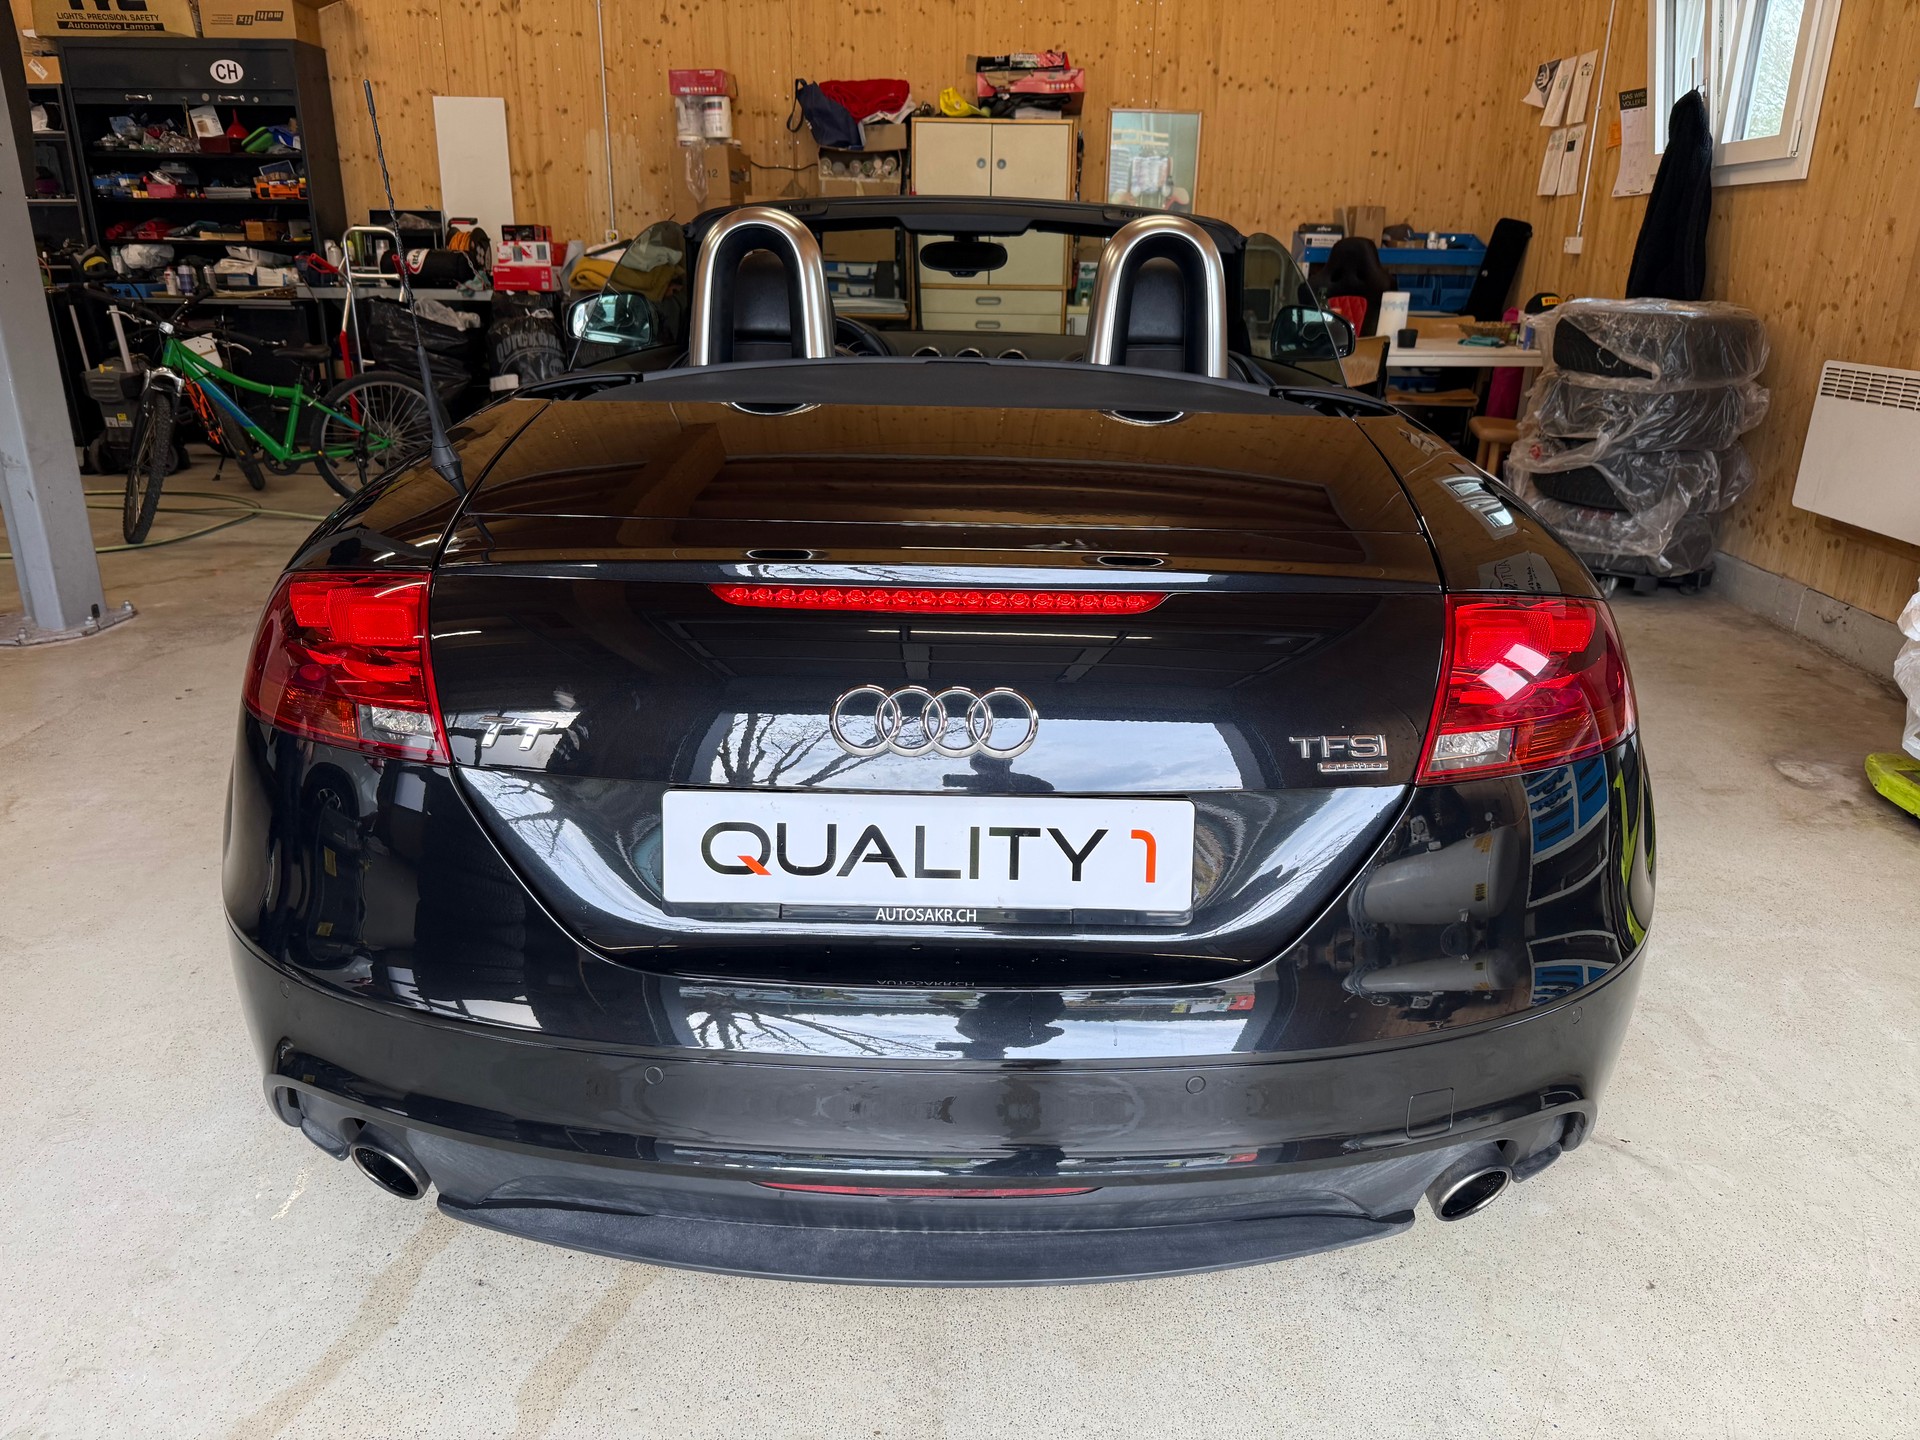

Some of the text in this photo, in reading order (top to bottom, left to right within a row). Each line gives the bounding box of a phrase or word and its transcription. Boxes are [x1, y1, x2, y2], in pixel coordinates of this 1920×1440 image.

[131, 14, 159, 22] SAFETY
[256, 11, 283, 21] multi
[67, 21, 156, 32] Automotive Lamps
[215, 63, 239, 80] CH
[478, 715, 558, 751] TT
[1289, 734, 1388, 759] TFSI
[701, 821, 1157, 884] QUALITY 1
[875, 907, 977, 922] AUTOSAKR.CH
